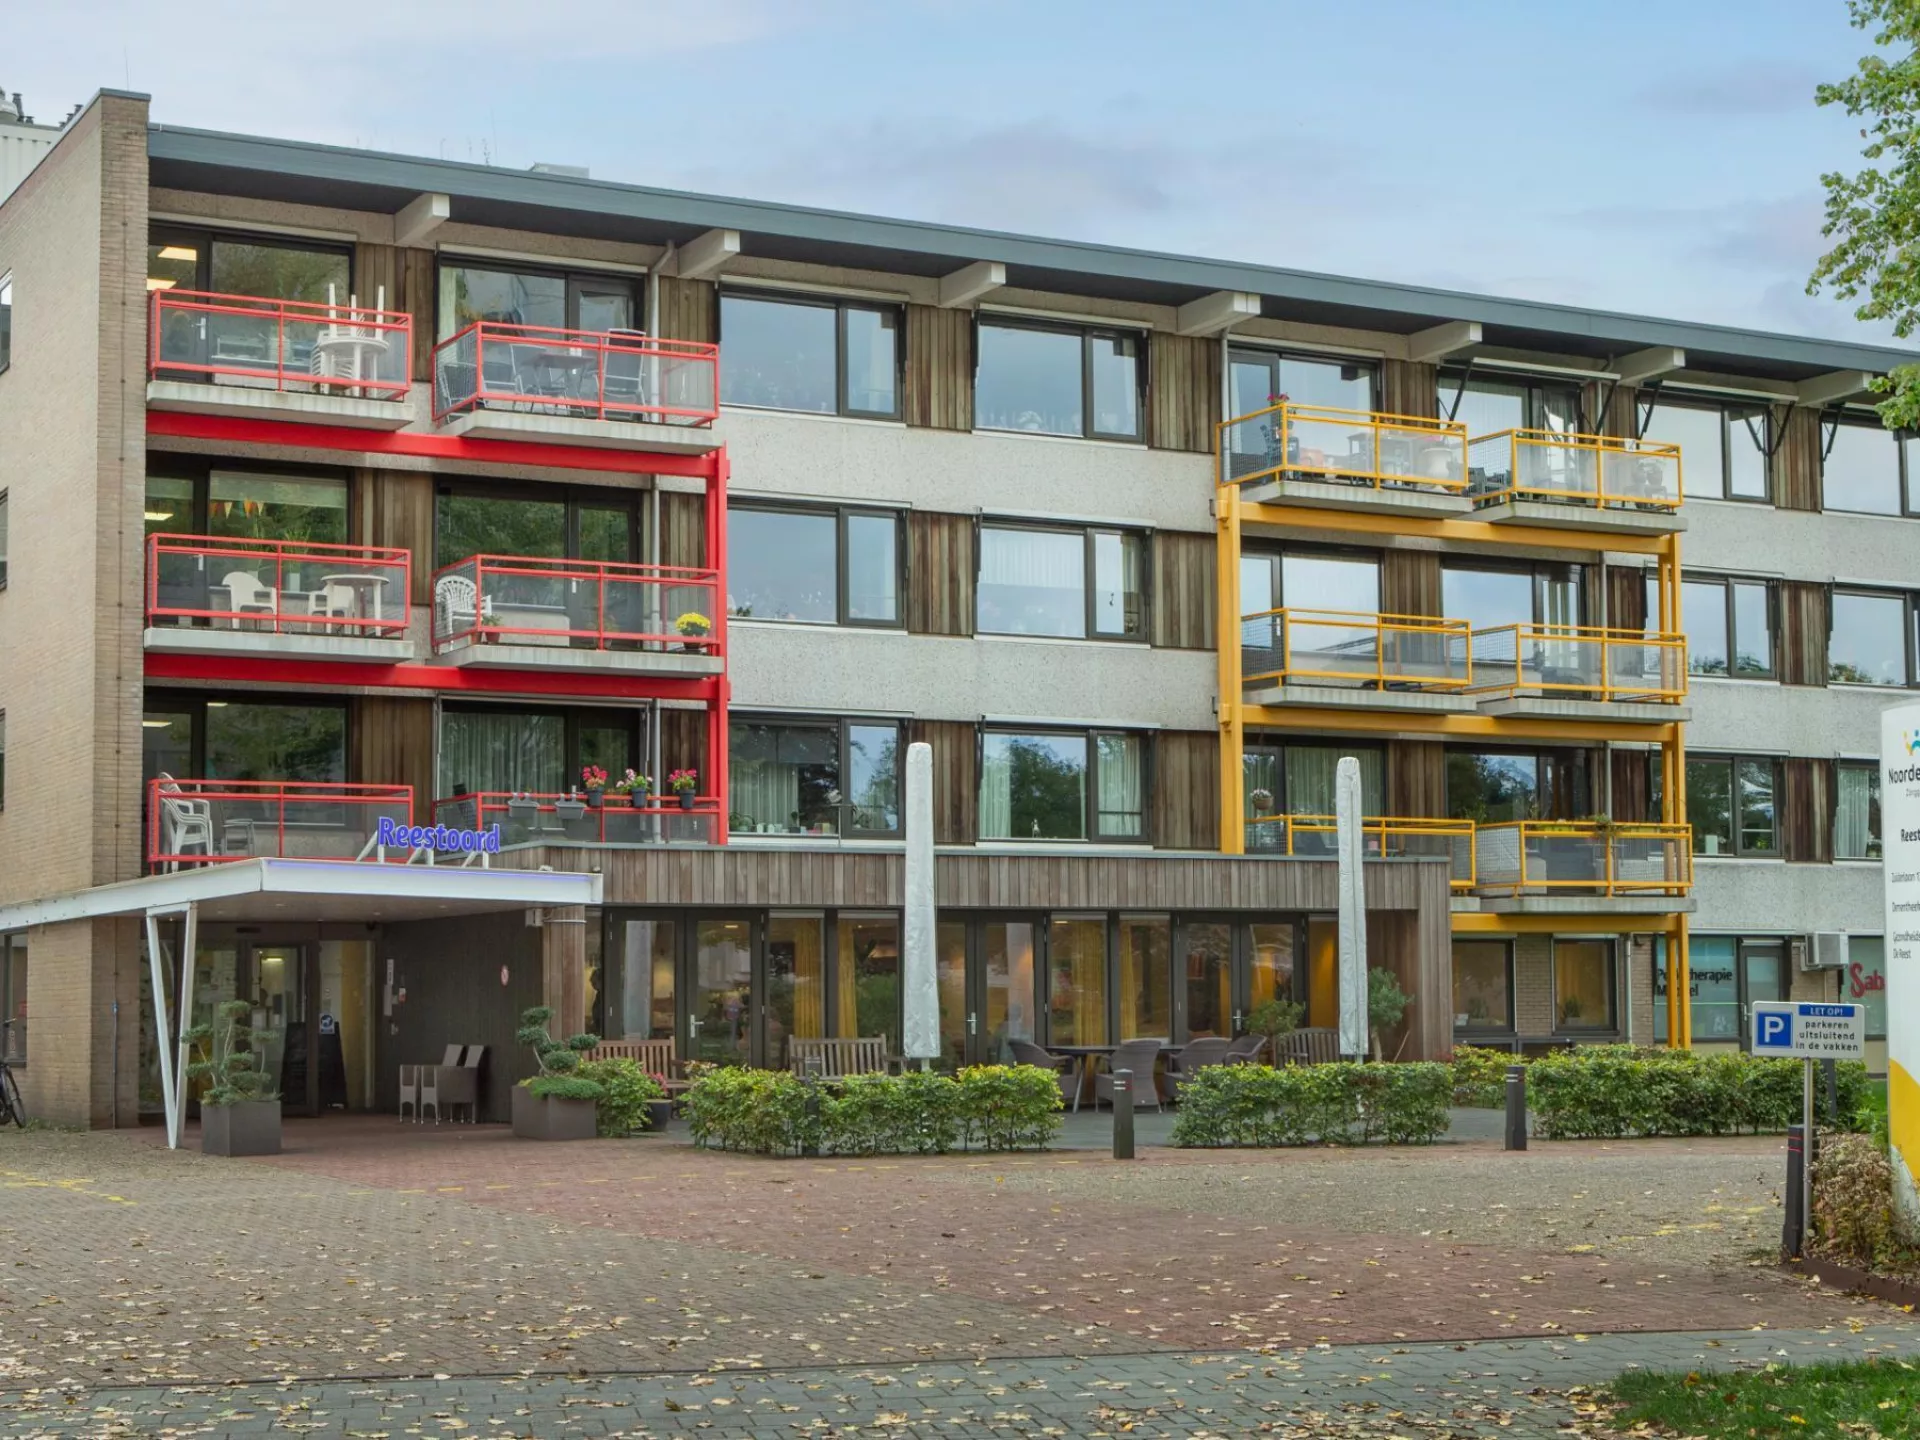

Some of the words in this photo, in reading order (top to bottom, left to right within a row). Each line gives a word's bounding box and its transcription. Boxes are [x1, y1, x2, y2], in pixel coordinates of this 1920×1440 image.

[378, 816, 500, 854] Reestoord
[1810, 1007, 1827, 1015] LET
[1827, 1007, 1843, 1016] OP!
[1764, 1016, 1785, 1044] P
[1805, 1020, 1849, 1030] parkeren
[1799, 1031, 1855, 1040] uitsluitend
[1808, 1042, 1820, 1050] de
[1823, 1042, 1859, 1052] vakken
